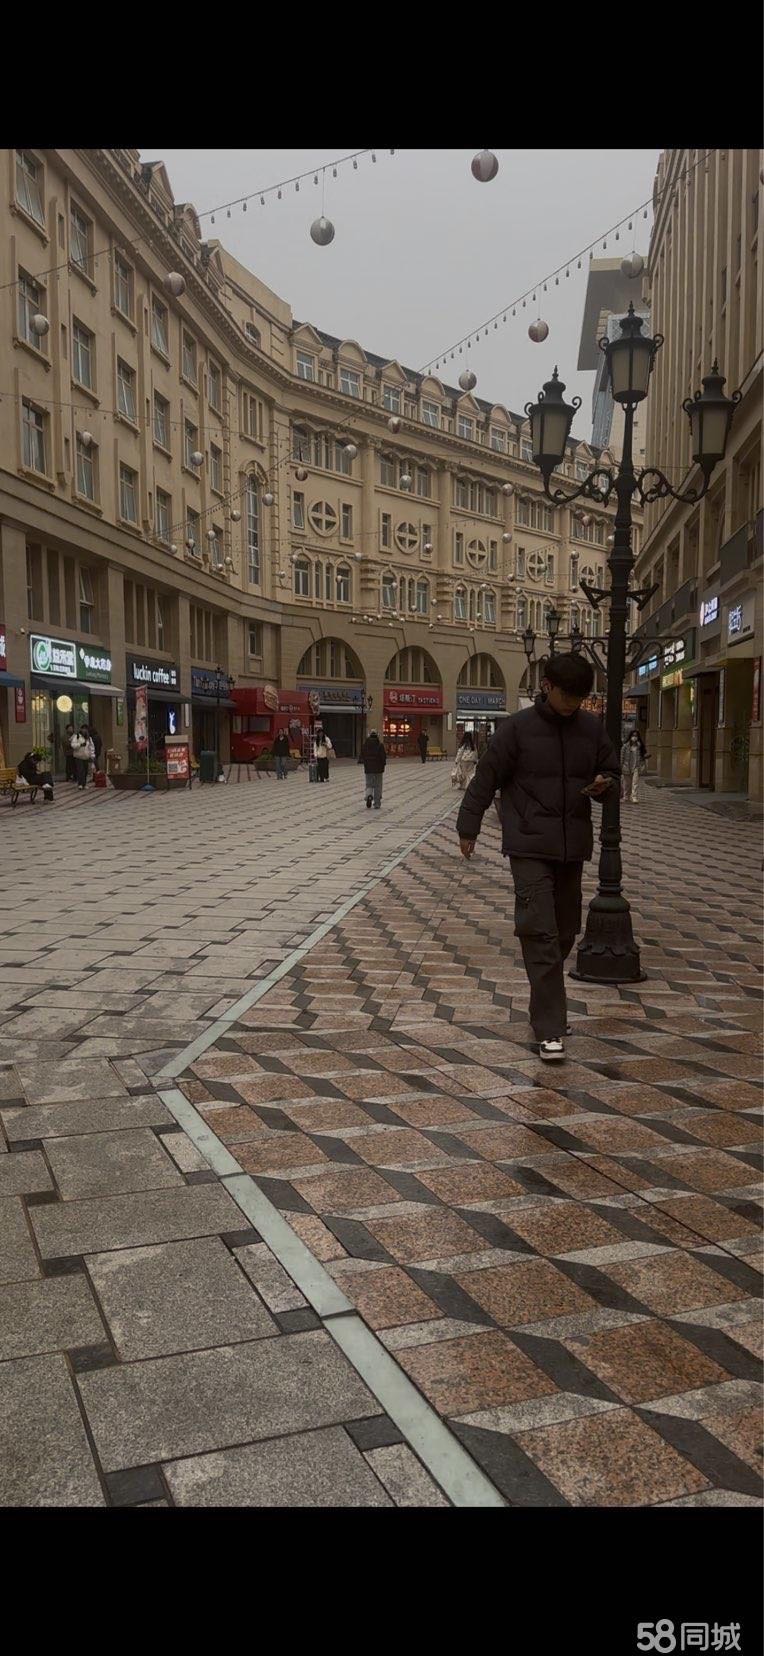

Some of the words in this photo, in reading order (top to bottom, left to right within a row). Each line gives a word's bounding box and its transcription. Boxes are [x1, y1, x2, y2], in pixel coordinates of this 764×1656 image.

[133, 662, 151, 682] luckin
[152, 667, 170, 685] coffee
[458, 695, 470, 704] ONE
[470, 695, 481, 704] DAY
